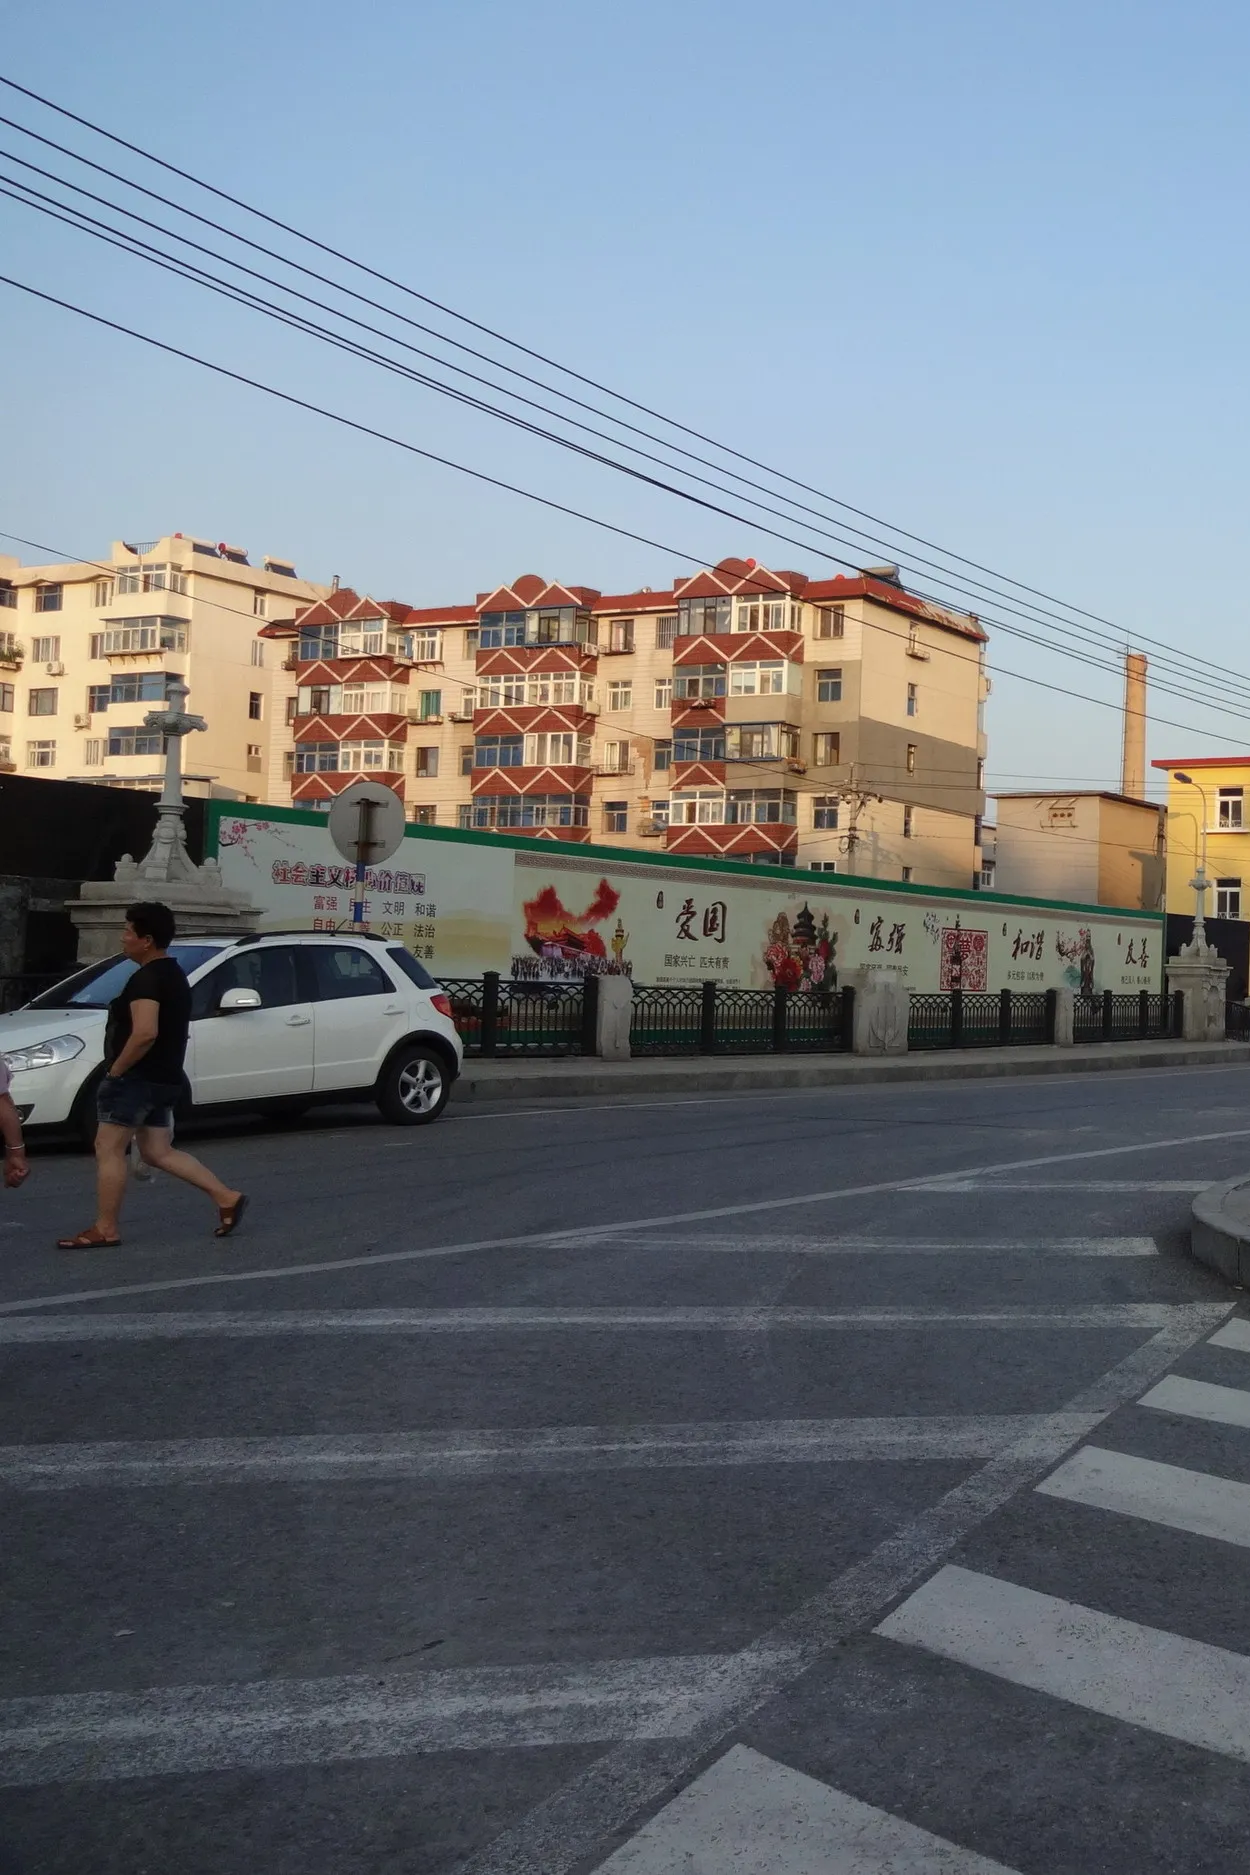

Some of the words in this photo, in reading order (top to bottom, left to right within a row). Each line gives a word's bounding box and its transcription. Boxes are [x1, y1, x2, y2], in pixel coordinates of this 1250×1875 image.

[313, 895, 338, 911] 富强
[382, 901, 405, 916] 文明
[415, 903, 437, 918] 和谐
[313, 918, 336, 931] 自由
[381, 922, 404, 937] 公正
[413, 924, 436, 939] 法治
[676, 898, 727, 943] 爱国
[412, 943, 435, 959] 友善
[1012, 928, 1044, 960] 和谐
[664, 954, 696, 967] 国家兴亡
[699, 956, 730, 969] 匹夫有责
